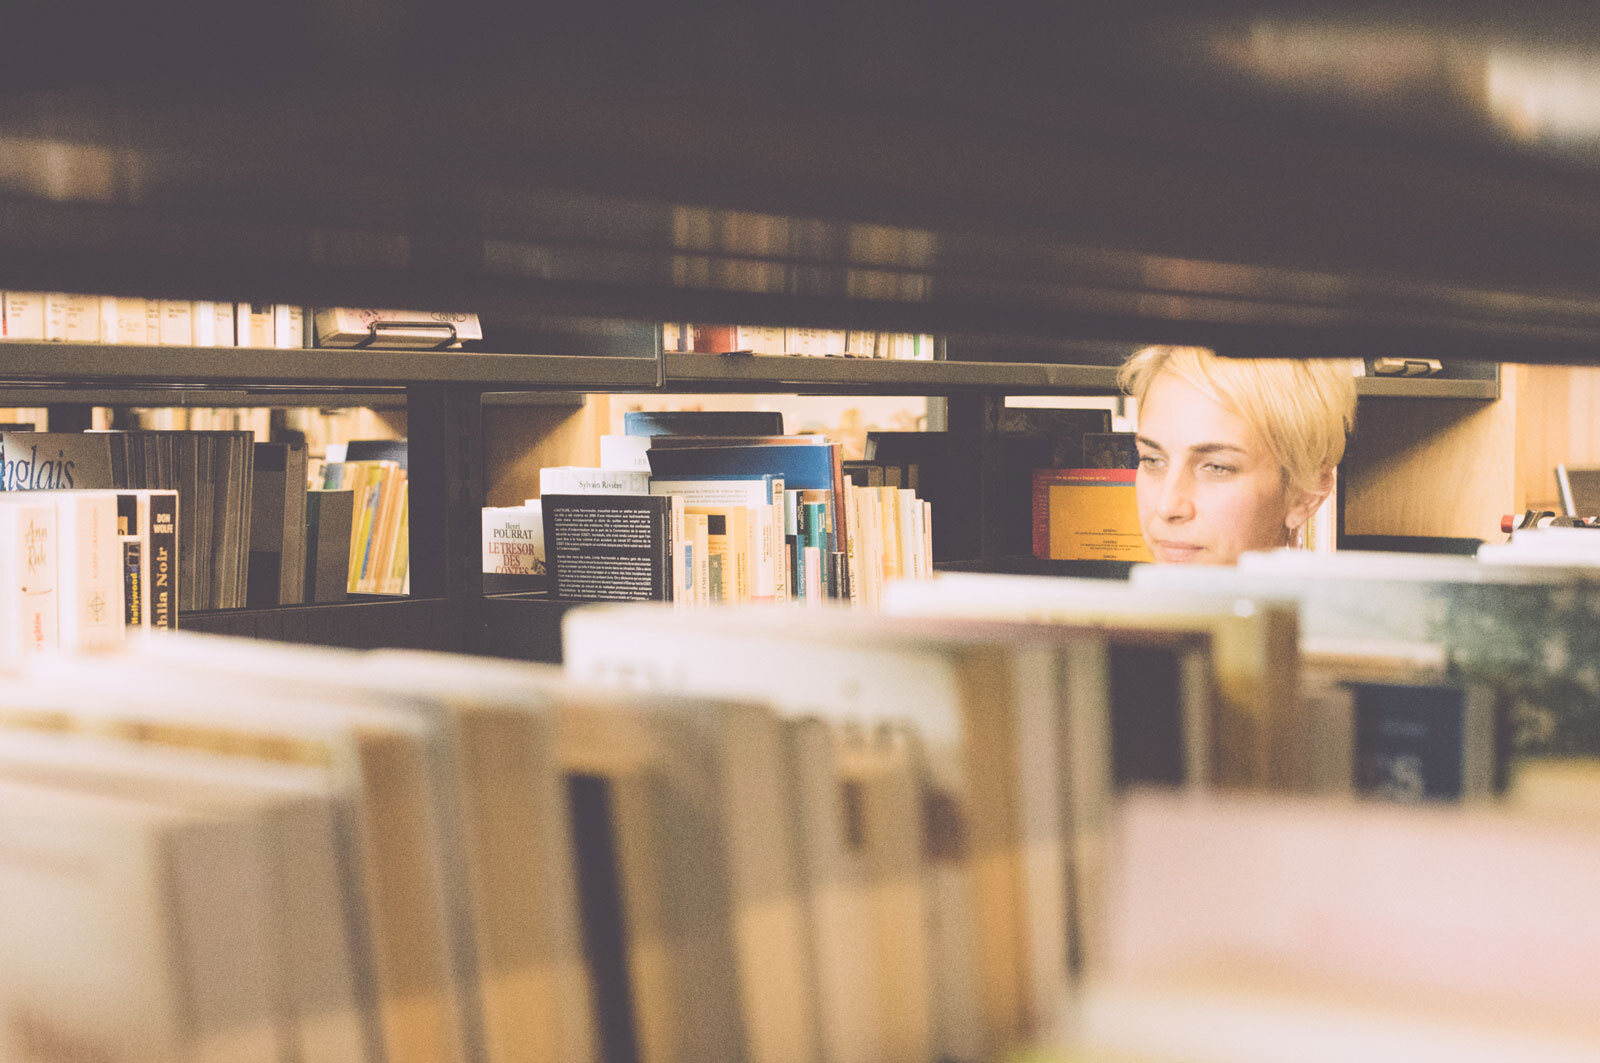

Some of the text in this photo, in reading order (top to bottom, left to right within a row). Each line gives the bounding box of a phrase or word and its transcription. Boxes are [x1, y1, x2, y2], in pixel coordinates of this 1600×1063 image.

[579, 481, 600, 491] Sylvain
[602, 481, 623, 489] Rivière
[157, 513, 170, 523] DON
[153, 524, 173, 533] WOLFE
[493, 528, 533, 539] POURRAT
[488, 542, 499, 554] LE
[503, 554, 521, 567] DES
[156, 546, 168, 587] Noir
[130, 573, 139, 624] Hollywood
